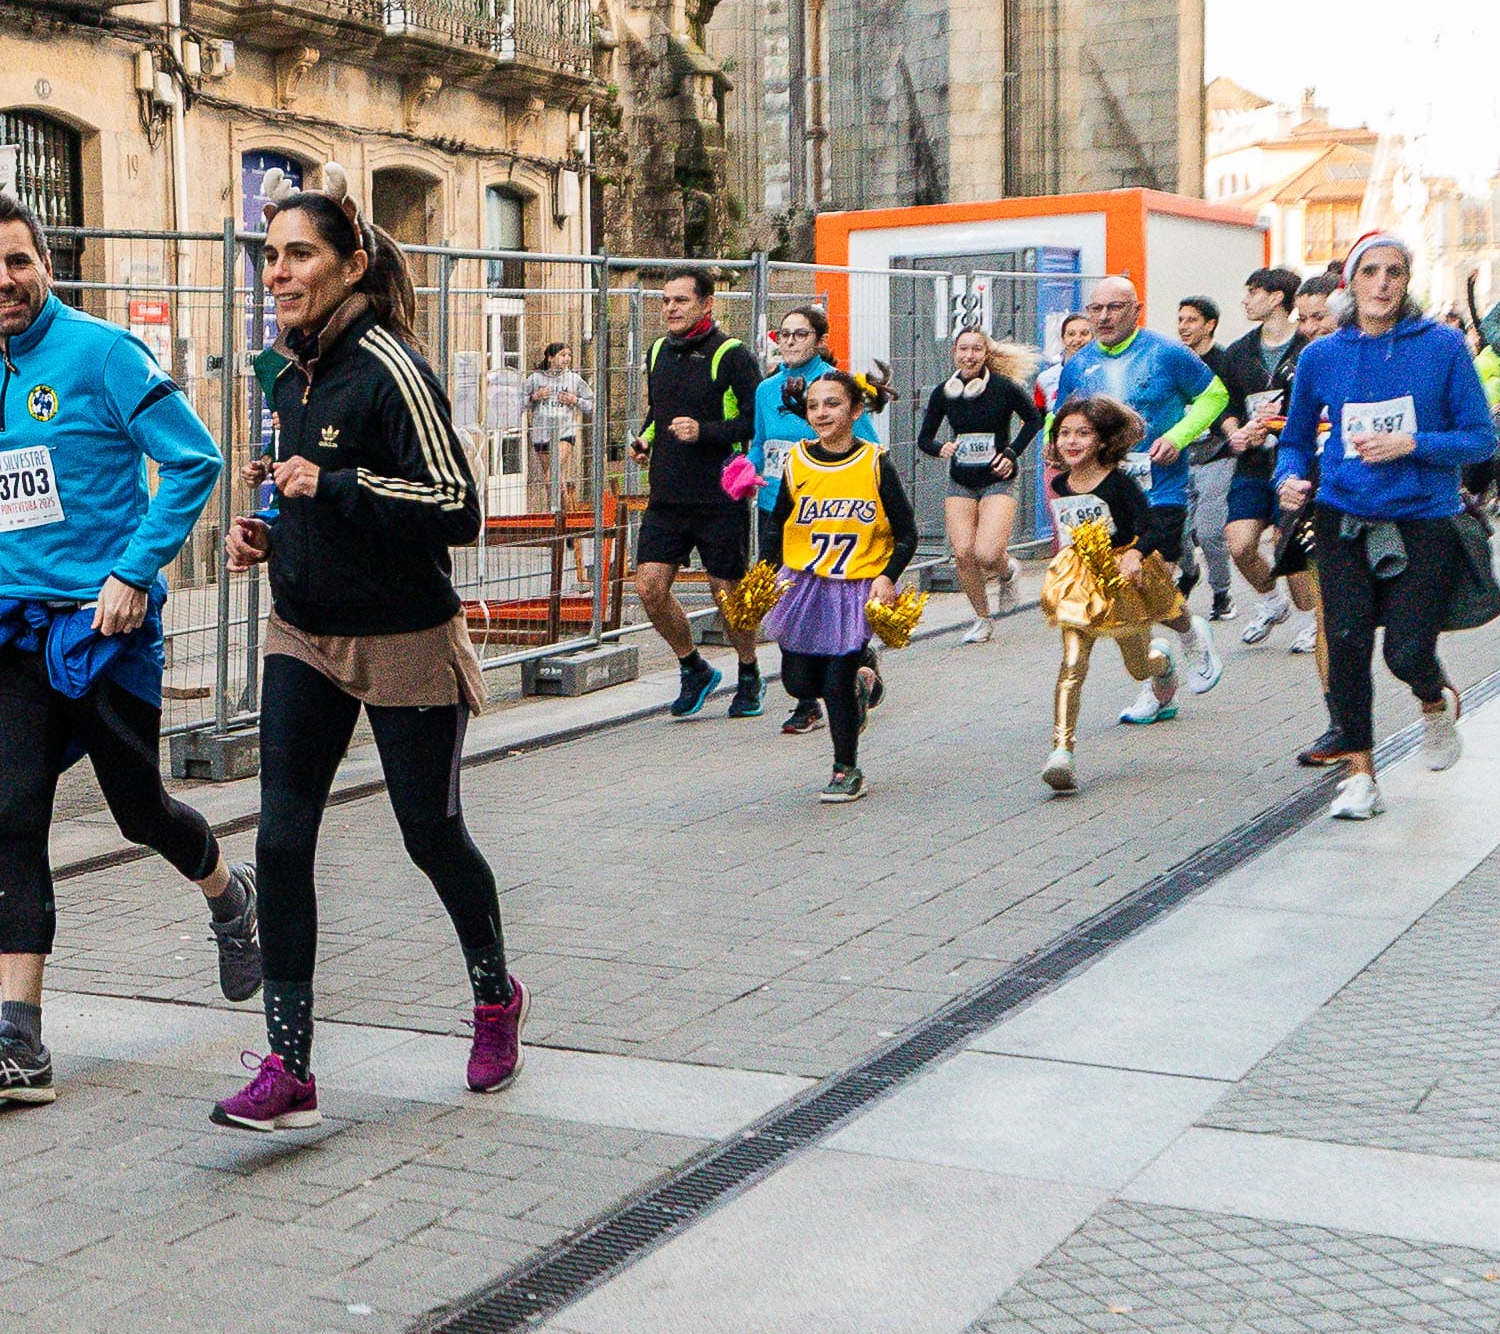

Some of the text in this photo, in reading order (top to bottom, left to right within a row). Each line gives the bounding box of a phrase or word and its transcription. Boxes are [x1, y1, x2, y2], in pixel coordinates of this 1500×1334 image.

[126, 154, 139, 181] 19
[0, 450, 46, 471] SILVESTRE
[39, 497, 56, 509] 2025
[794, 496, 878, 526] LAKERS
[804, 533, 860, 578] 77
